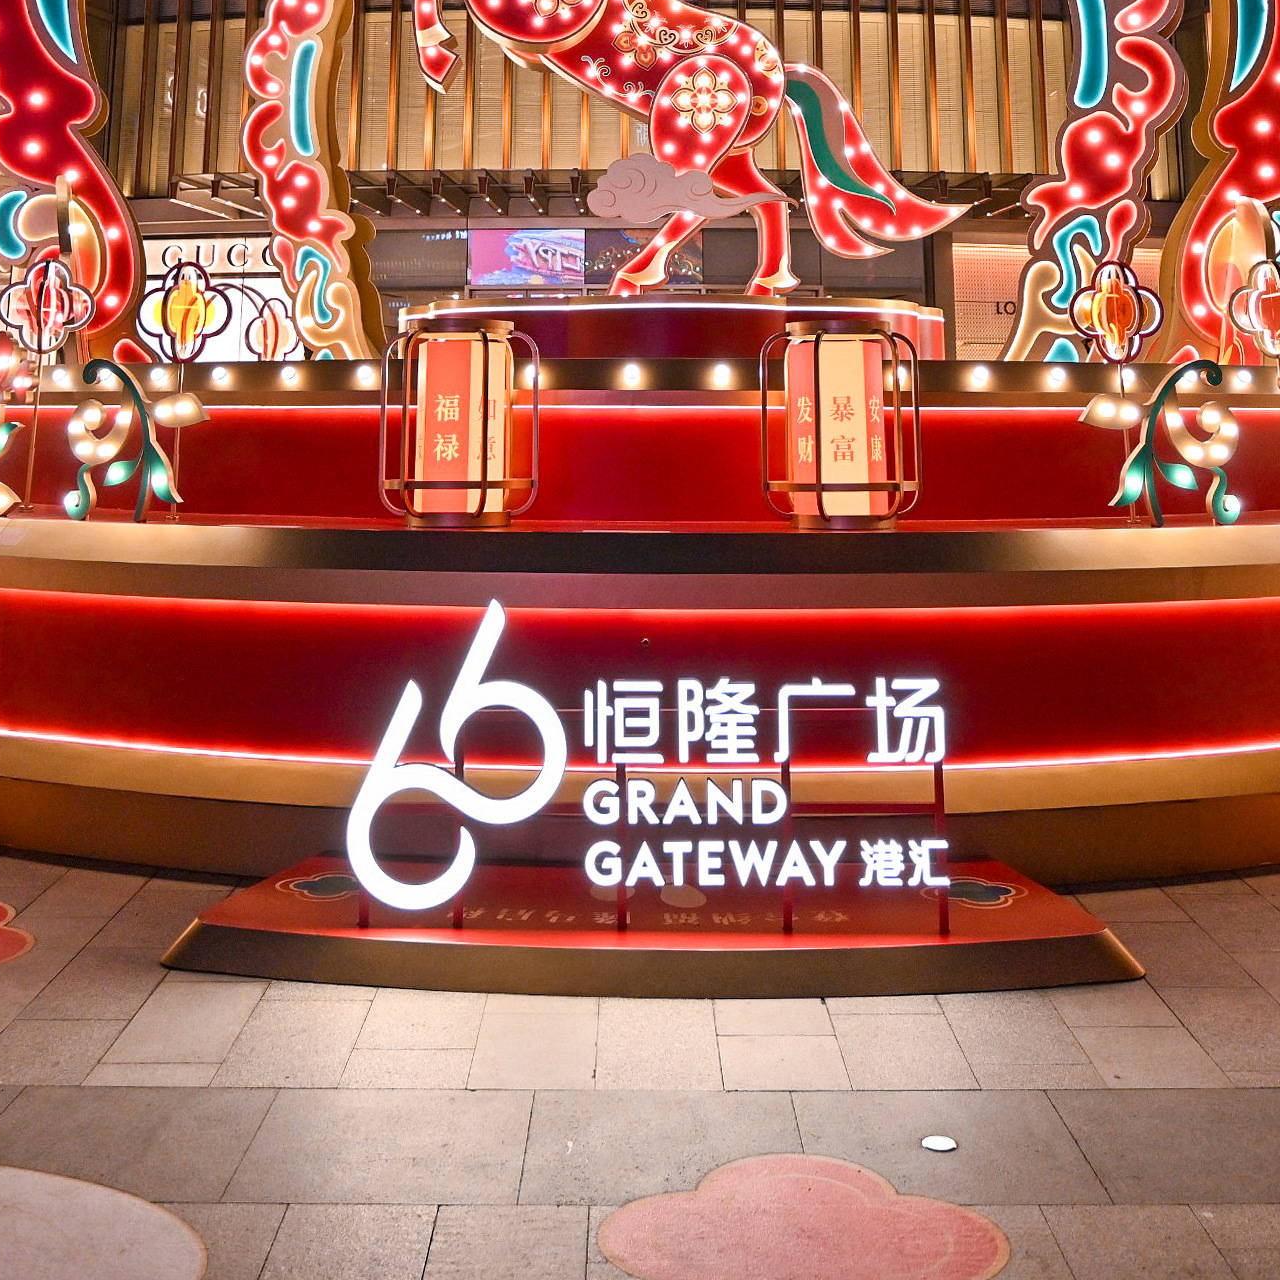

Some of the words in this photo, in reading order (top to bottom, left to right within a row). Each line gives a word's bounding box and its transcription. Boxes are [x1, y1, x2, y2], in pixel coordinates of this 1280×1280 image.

[433, 394, 461, 462] 福禄
[477, 395, 497, 461] 如意
[796, 396, 815, 463] 发财
[829, 395, 857, 462] 暴富
[869, 395, 883, 462] 安康
[582, 676, 946, 764] 恒隆广场
[582, 778, 788, 825] GRAND
[583, 839, 847, 887] GATEWAY
[858, 839, 951, 887] 港汇
